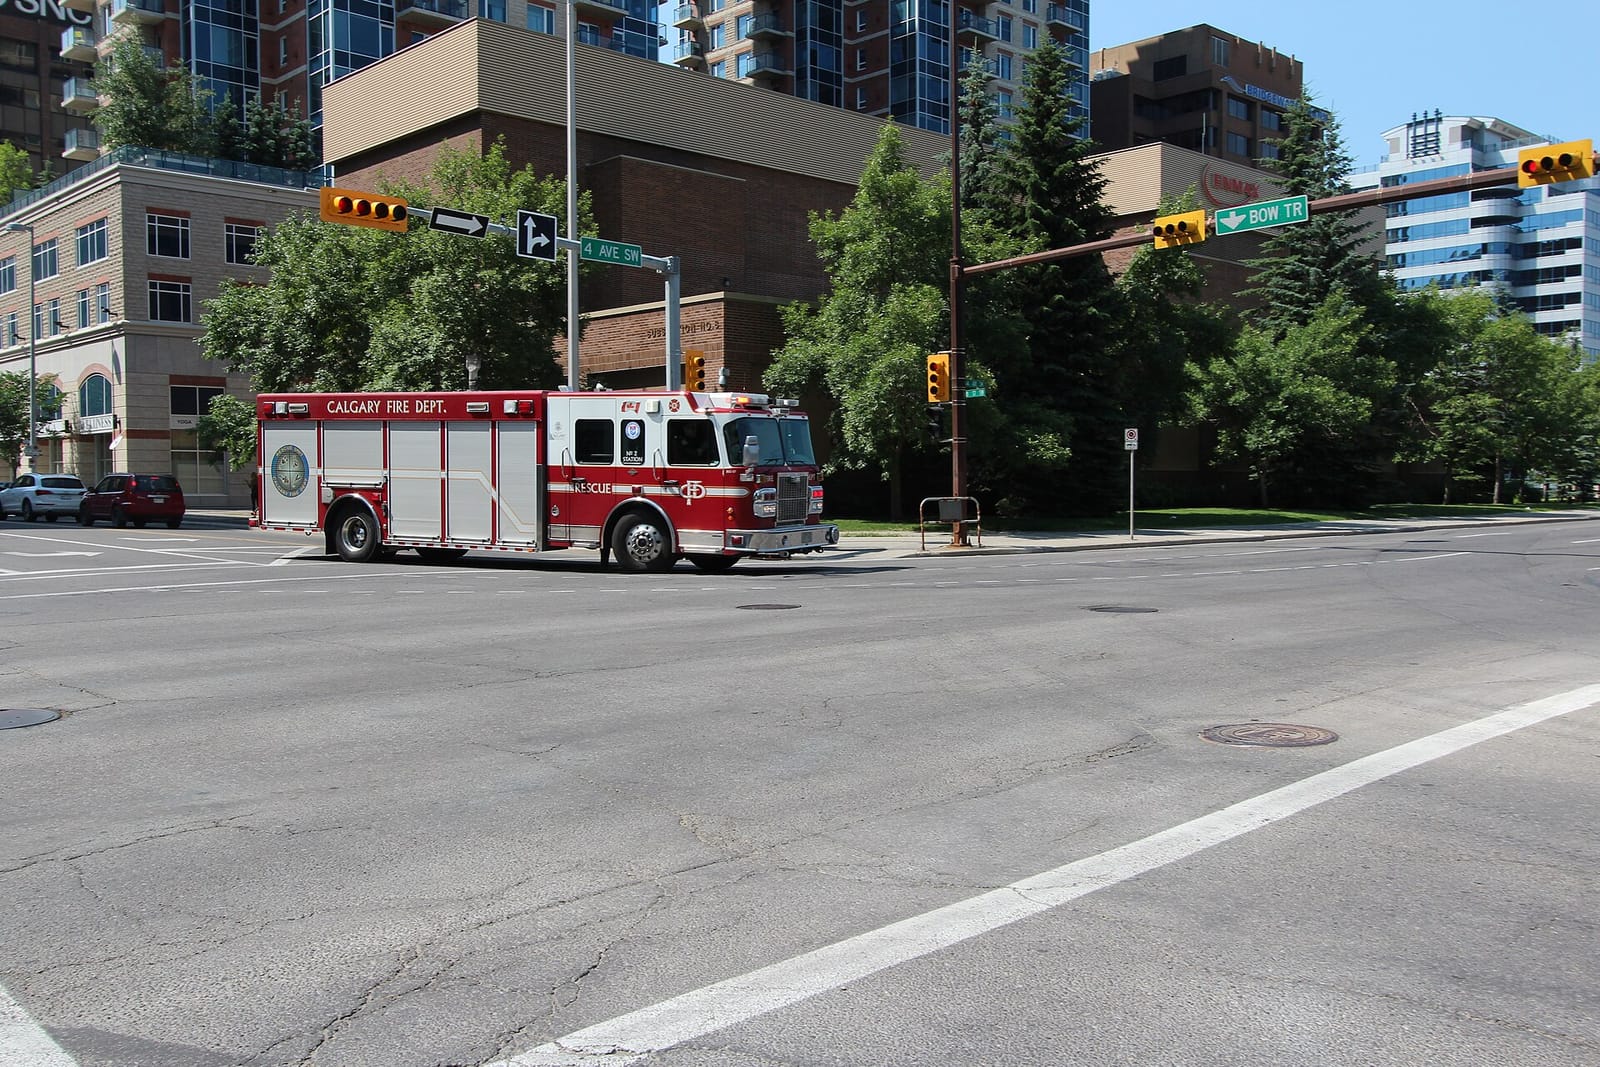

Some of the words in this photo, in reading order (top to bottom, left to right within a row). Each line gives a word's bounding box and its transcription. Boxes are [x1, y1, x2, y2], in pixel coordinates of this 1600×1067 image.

[1249, 205, 1279, 224] BOW
[1284, 202, 1303, 218] TR
[584, 242, 593, 255] 4
[599, 244, 620, 259] AVE
[624, 248, 639, 262] SW
[327, 400, 380, 413] CALGARY
[387, 400, 409, 413] FIRE
[415, 400, 447, 413] DEPT.
[575, 483, 611, 494] RESCUE
